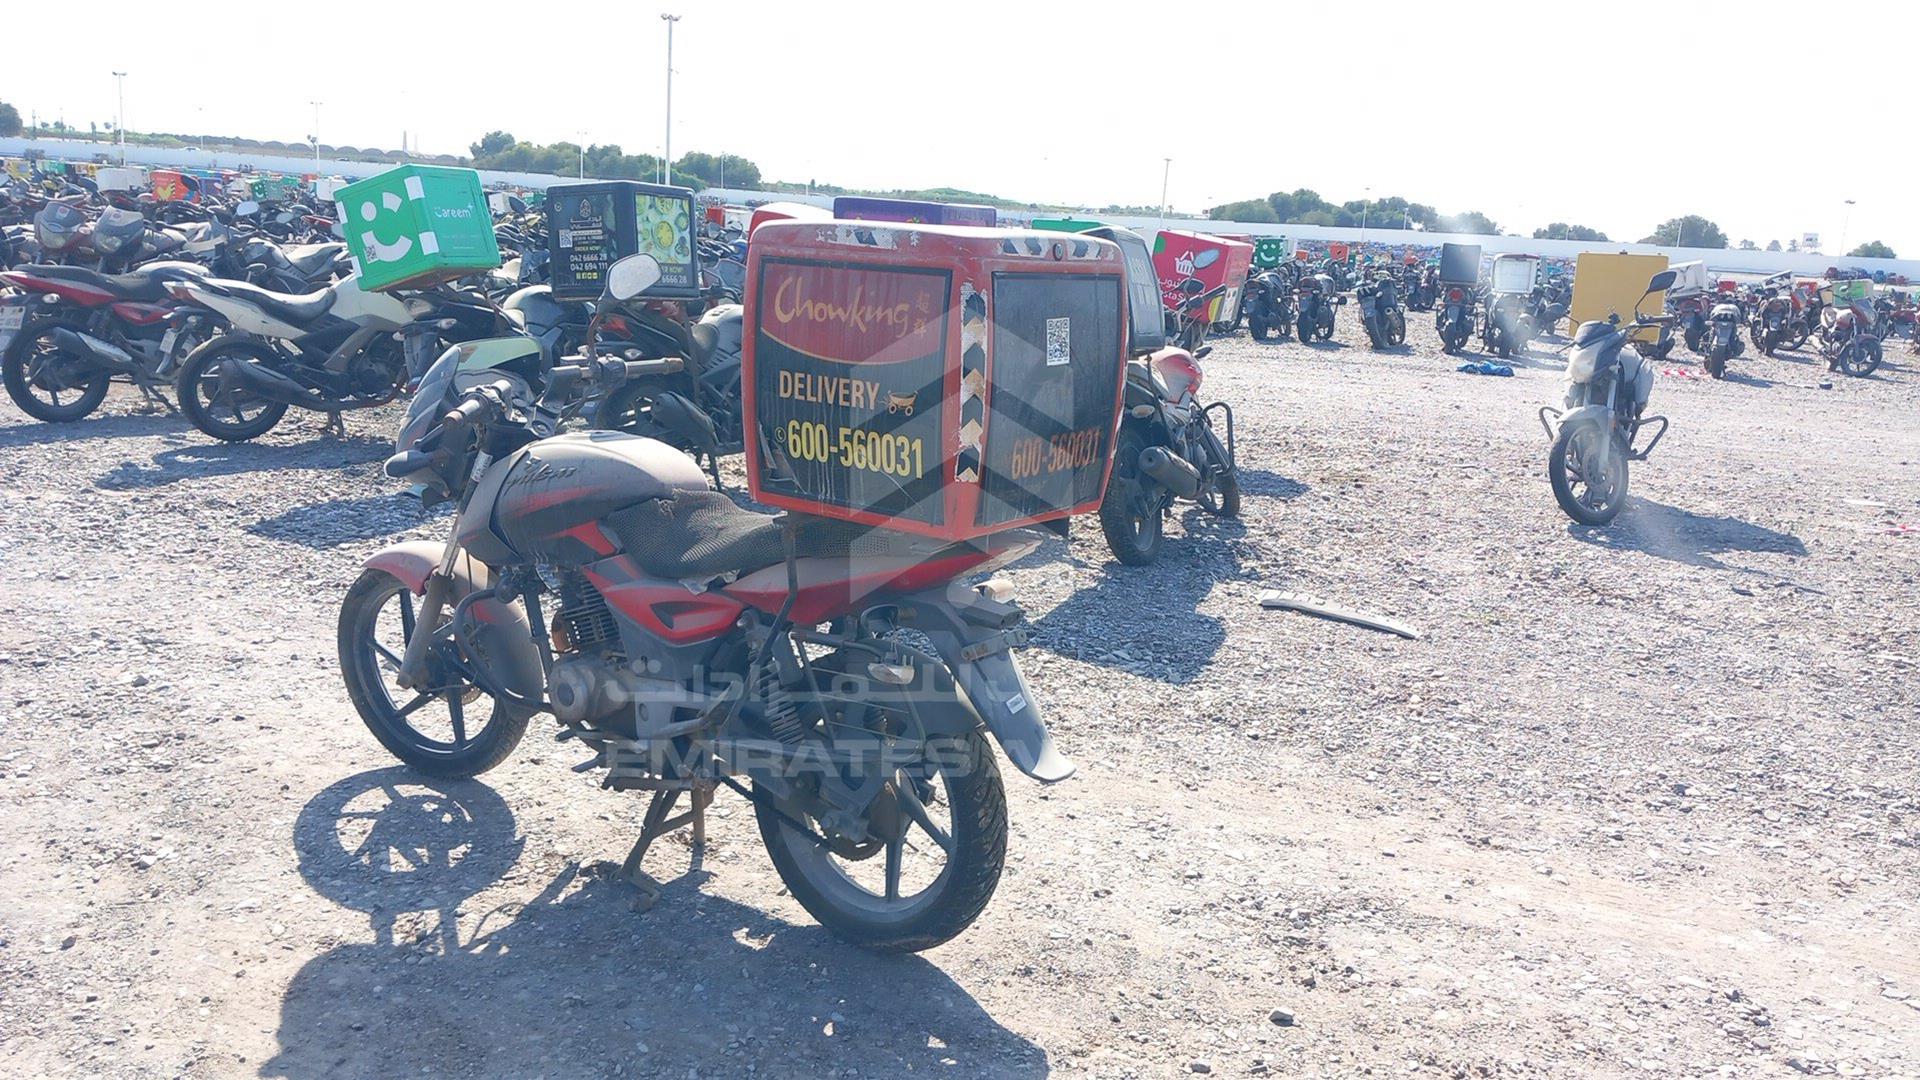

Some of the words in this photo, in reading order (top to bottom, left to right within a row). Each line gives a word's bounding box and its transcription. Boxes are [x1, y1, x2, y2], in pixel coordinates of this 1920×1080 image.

[775, 276, 910, 338] Chowking
[779, 370, 880, 410] DELIVERY
[787, 419, 923, 479] 600-560031
[1011, 428, 1102, 480] 600-560031
